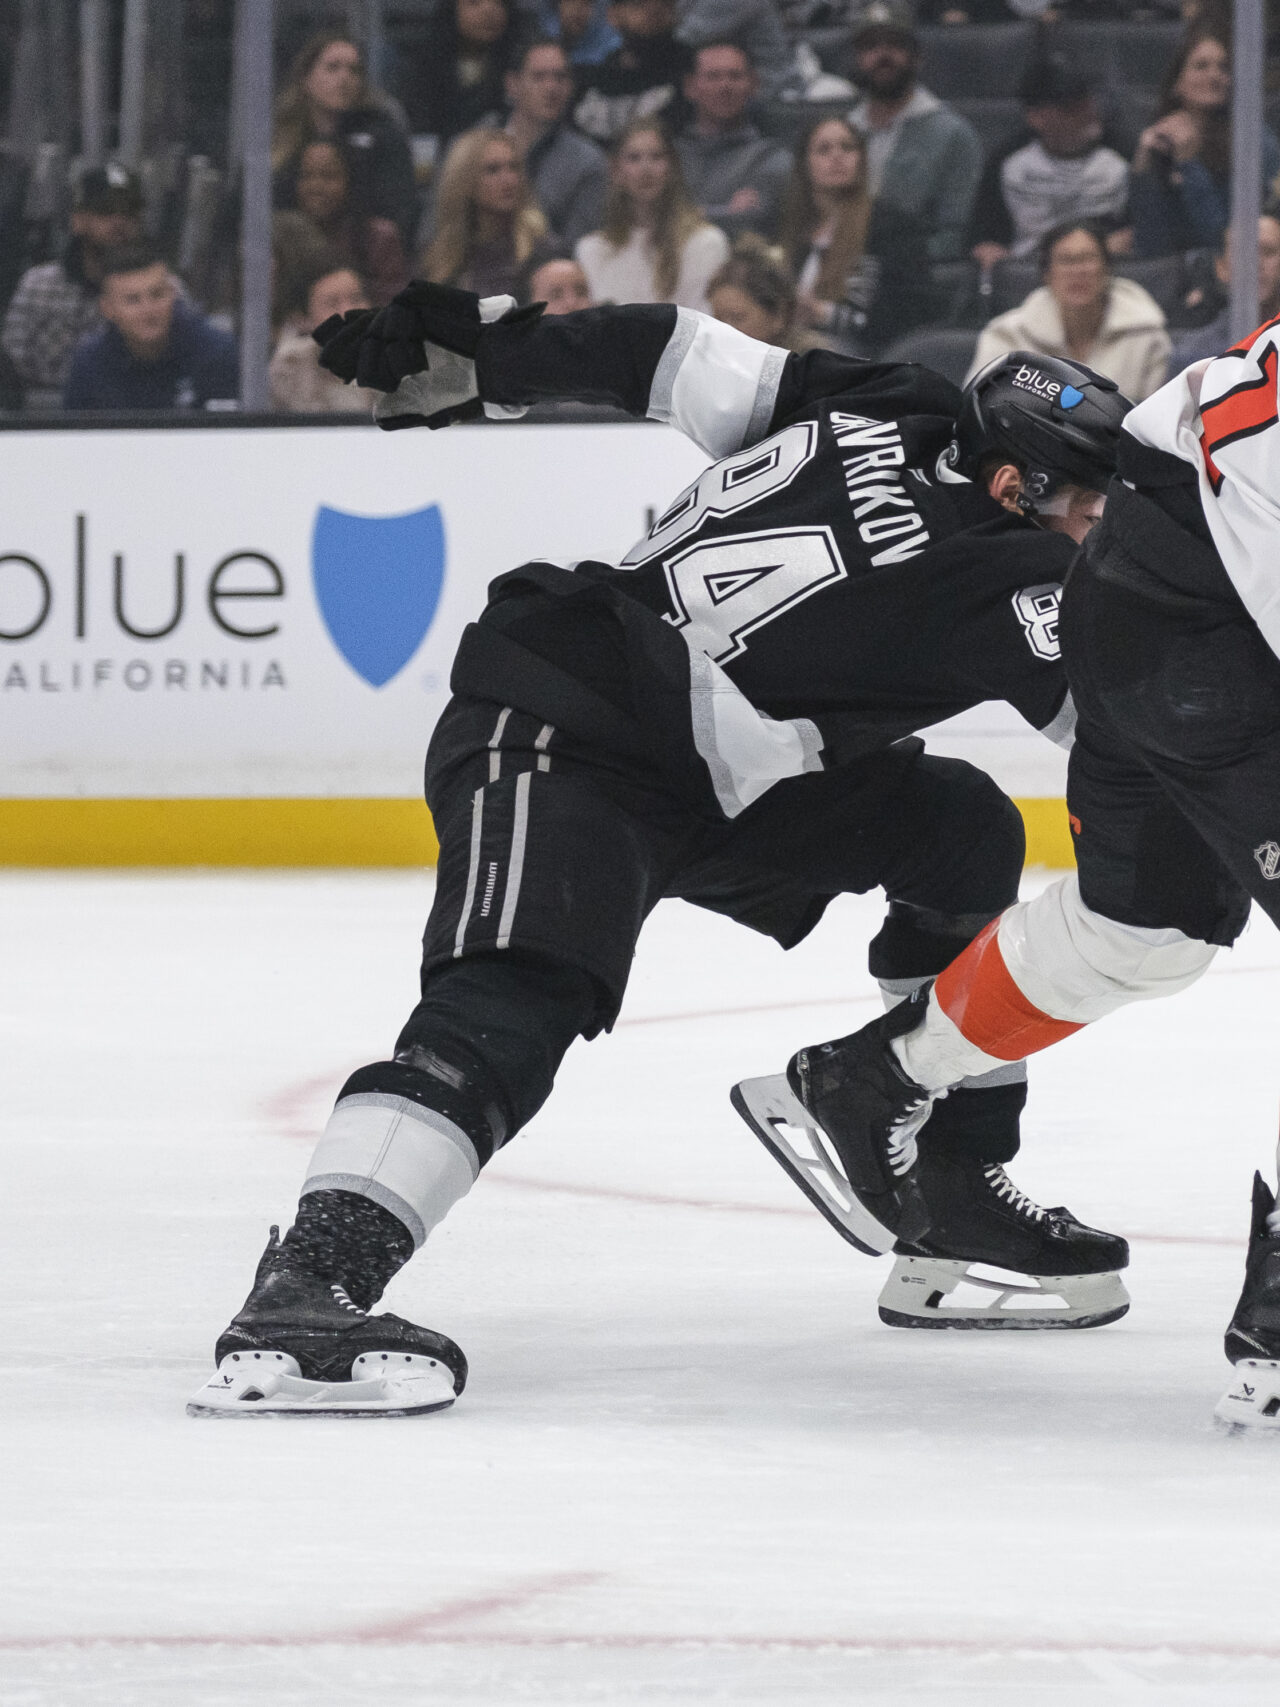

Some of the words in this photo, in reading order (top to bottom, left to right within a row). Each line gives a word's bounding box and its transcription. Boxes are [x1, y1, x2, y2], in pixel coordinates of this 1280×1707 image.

[1011, 380, 1055, 402] CALIFORNIA
[1015, 364, 1061, 396] blue
[615, 420, 848, 667] 84
[480, 862, 498, 917] WARRIOR
